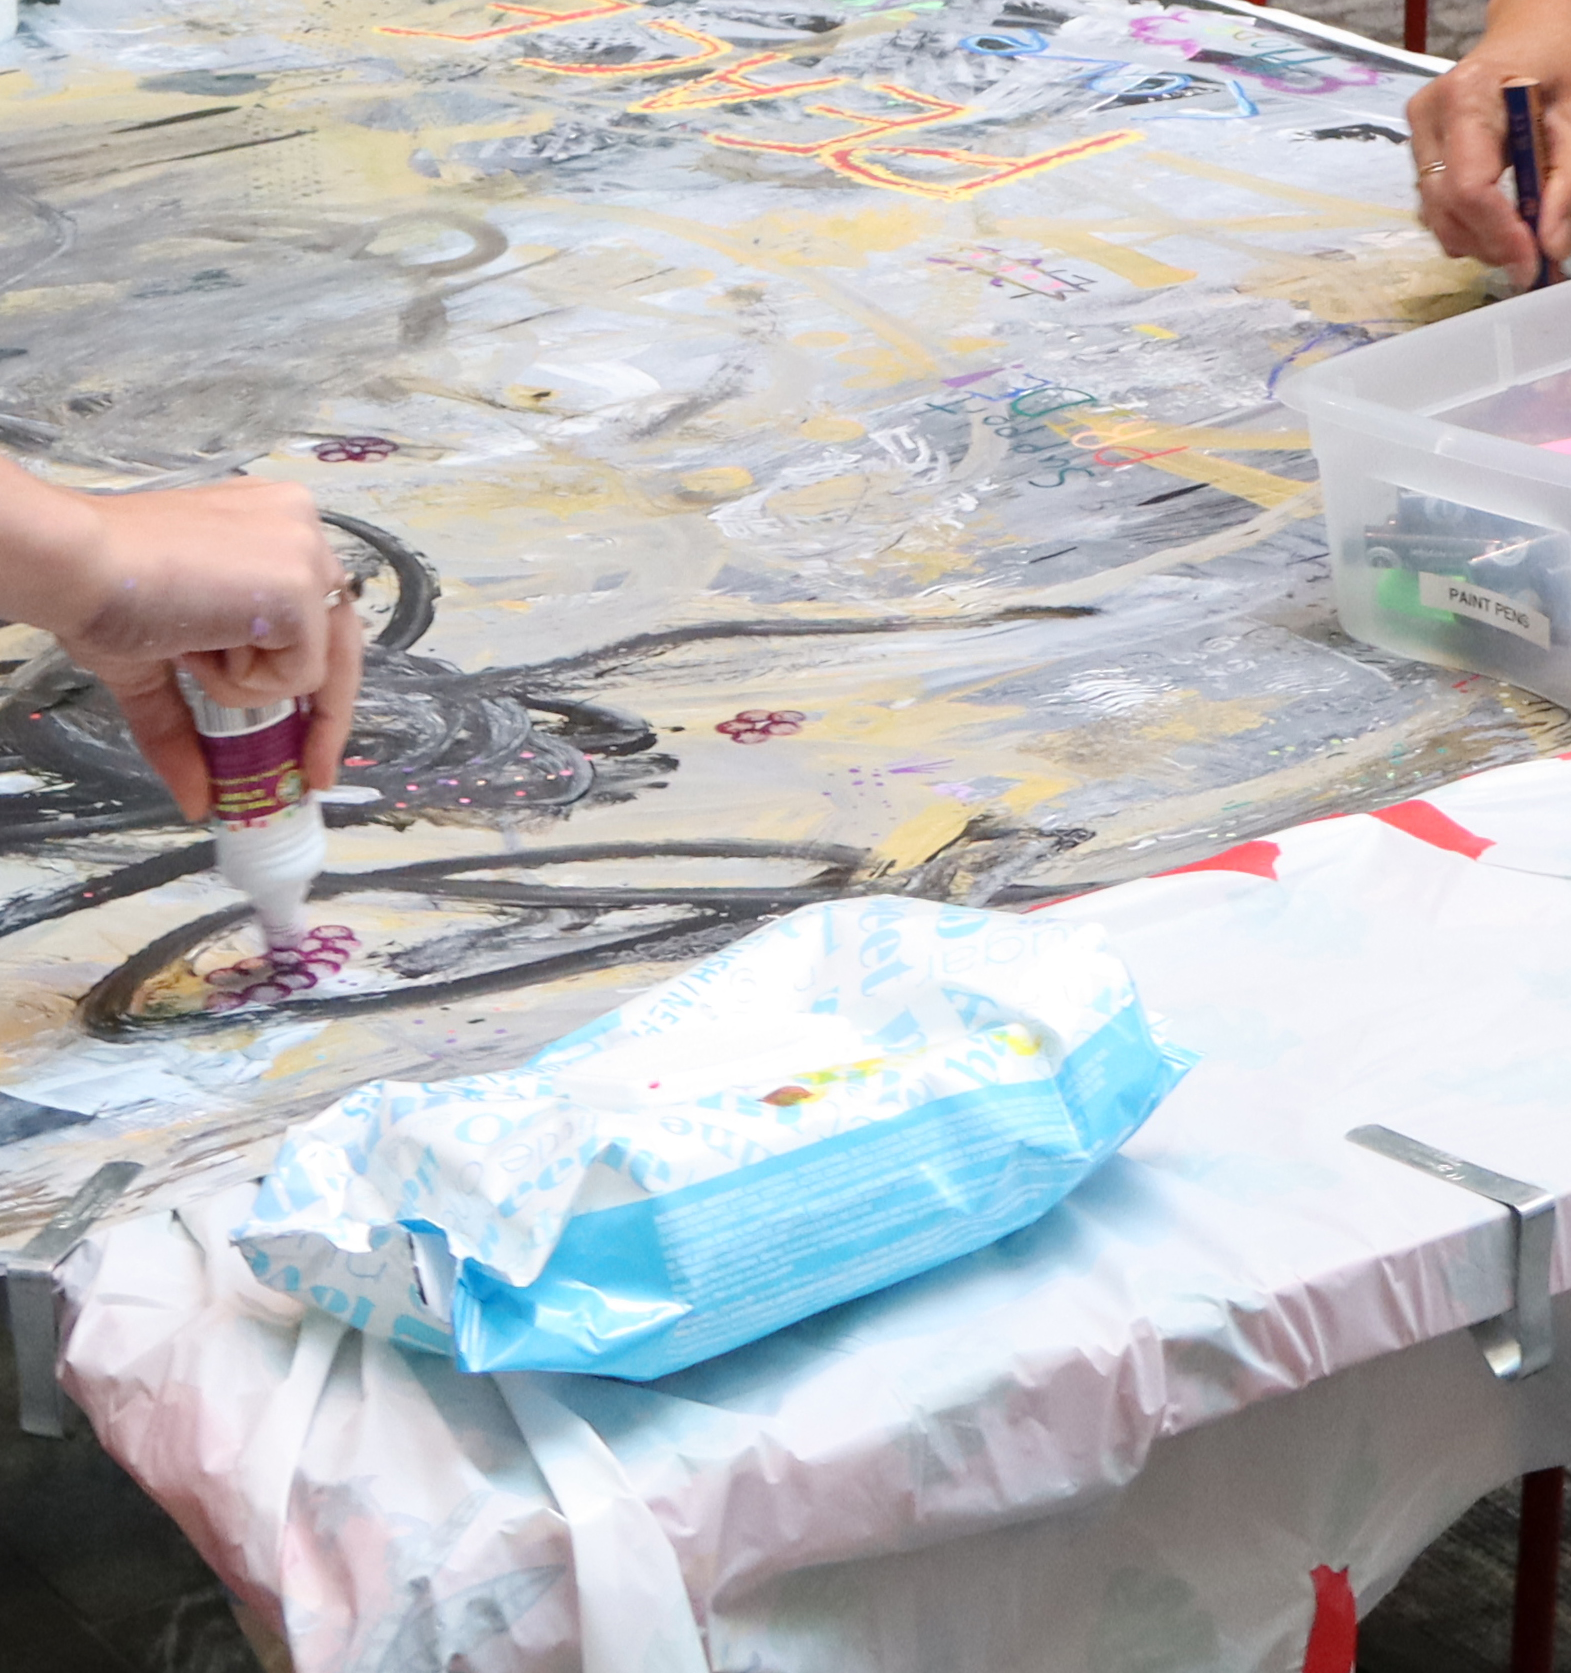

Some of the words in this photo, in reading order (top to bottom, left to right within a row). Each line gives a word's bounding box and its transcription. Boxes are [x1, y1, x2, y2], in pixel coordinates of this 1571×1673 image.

[914, 395, 1096, 489] Support
[1448, 587, 1490, 612] PAINT
[1494, 601, 1531, 629] PENS
